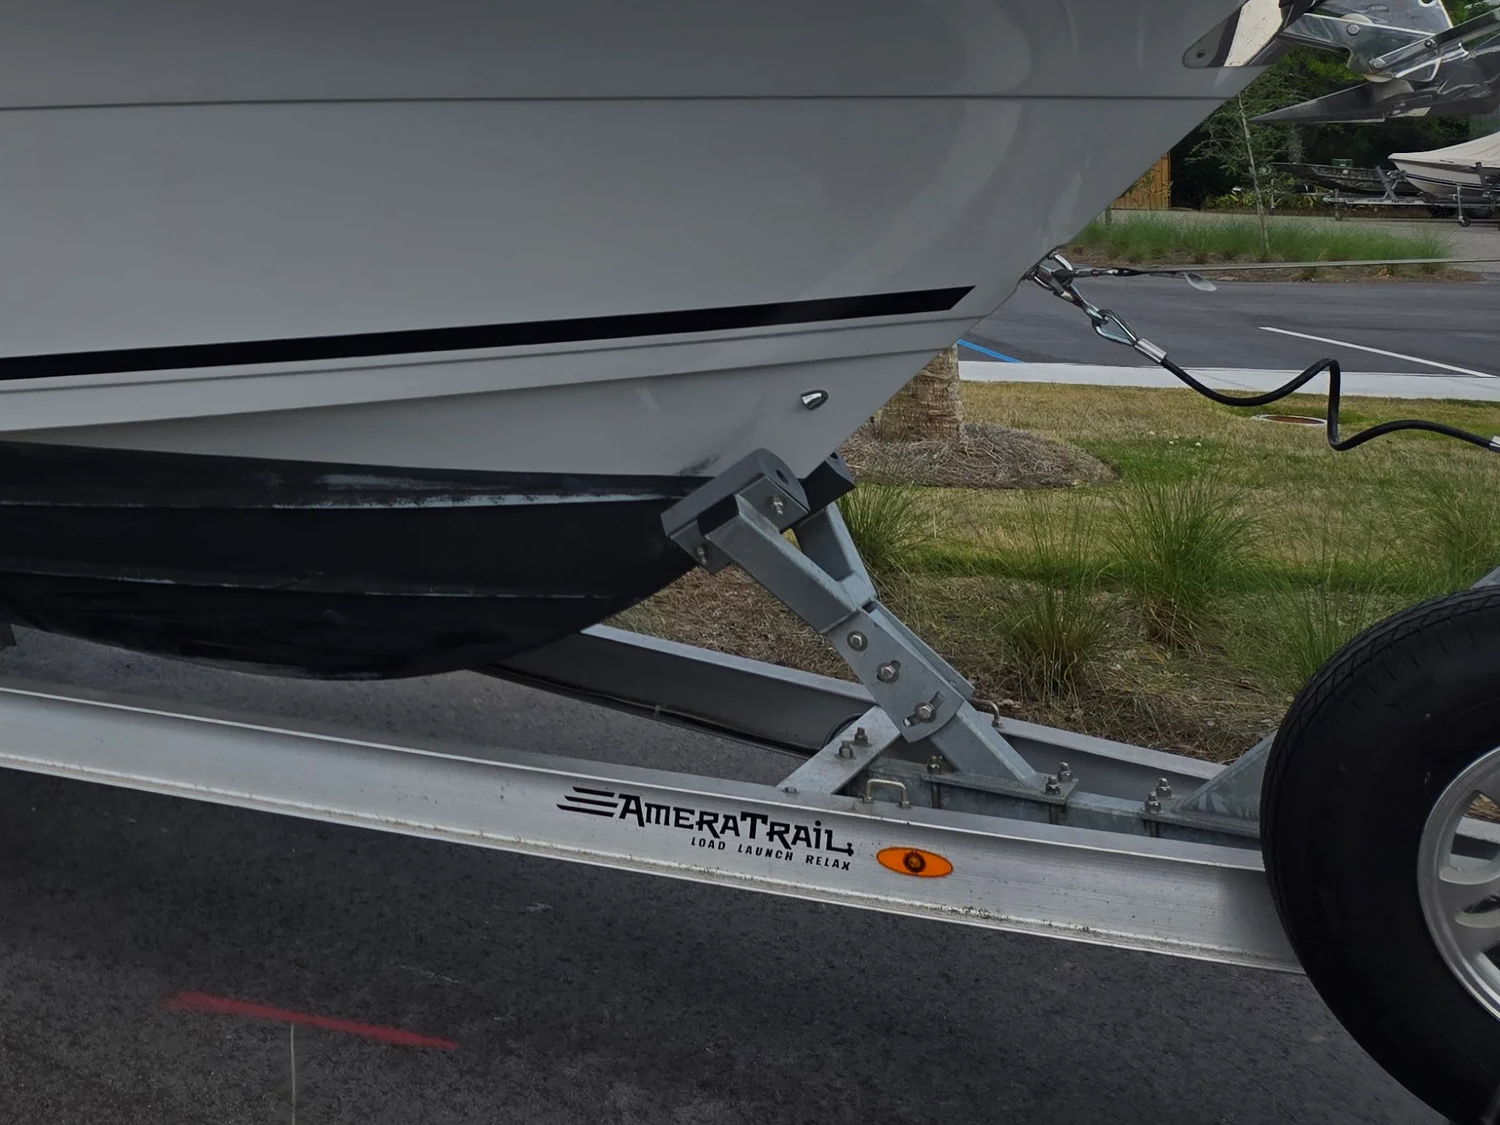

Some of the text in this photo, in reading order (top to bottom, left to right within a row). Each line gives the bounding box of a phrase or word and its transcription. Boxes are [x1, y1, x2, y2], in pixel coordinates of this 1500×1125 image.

[691, 836, 851, 871] LOAD LAUNCH RELAX
